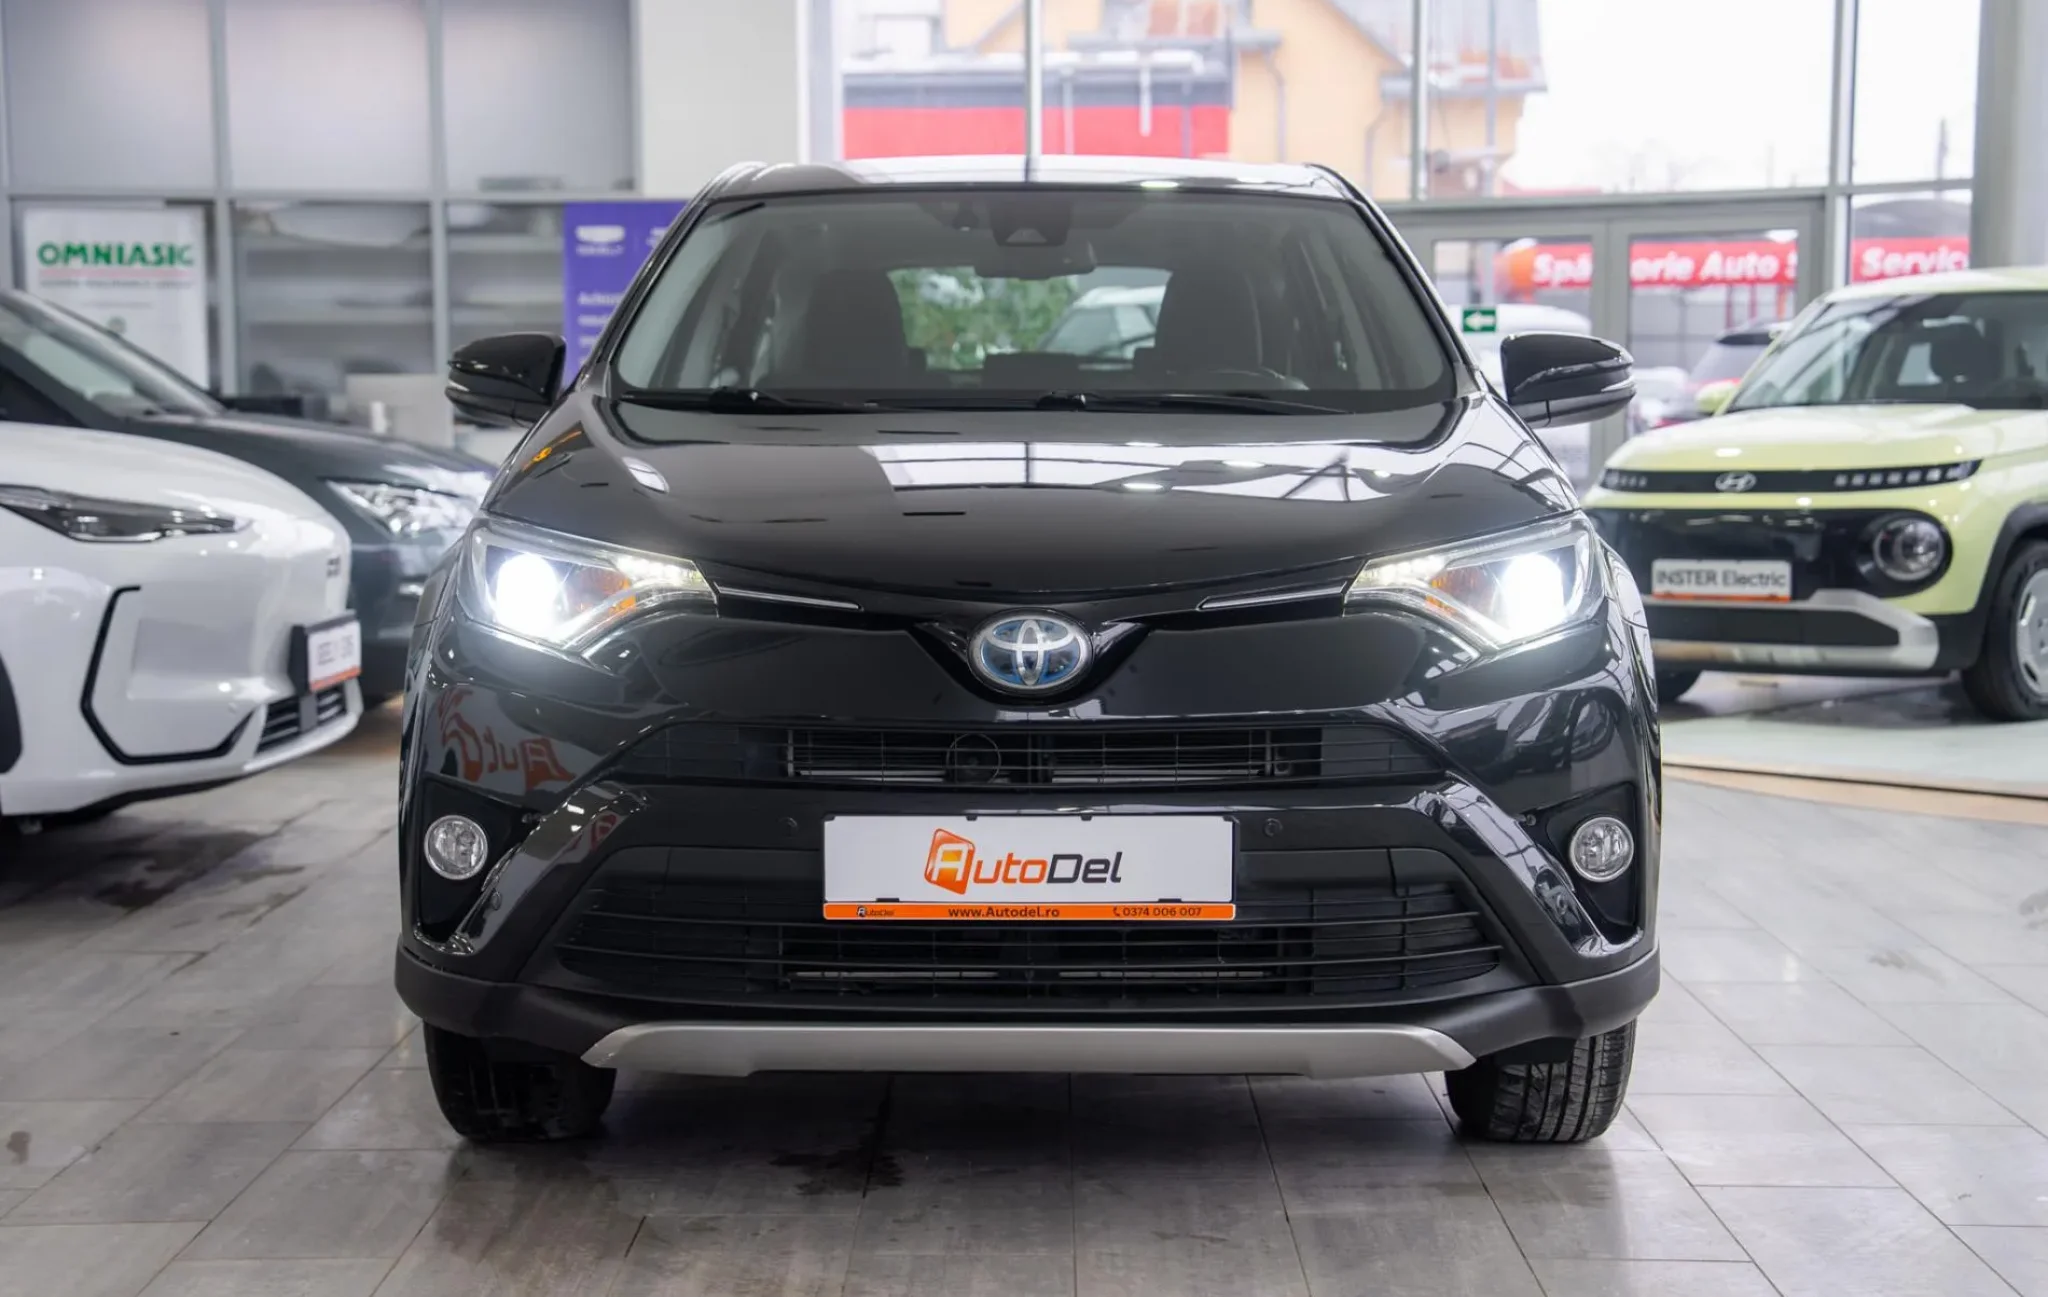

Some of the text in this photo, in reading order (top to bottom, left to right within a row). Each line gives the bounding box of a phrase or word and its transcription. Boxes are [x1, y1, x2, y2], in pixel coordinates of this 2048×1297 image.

[38, 242, 194, 266] OMNIASIC
[1701, 250, 1779, 281] Auto
[1862, 245, 1969, 277] Servic
[1721, 568, 1787, 589] Electric
[928, 839, 1123, 886] AutoDel
[948, 905, 1060, 918] www.Autodel.ro
[1123, 906, 1201, 917] 0374 006 007
